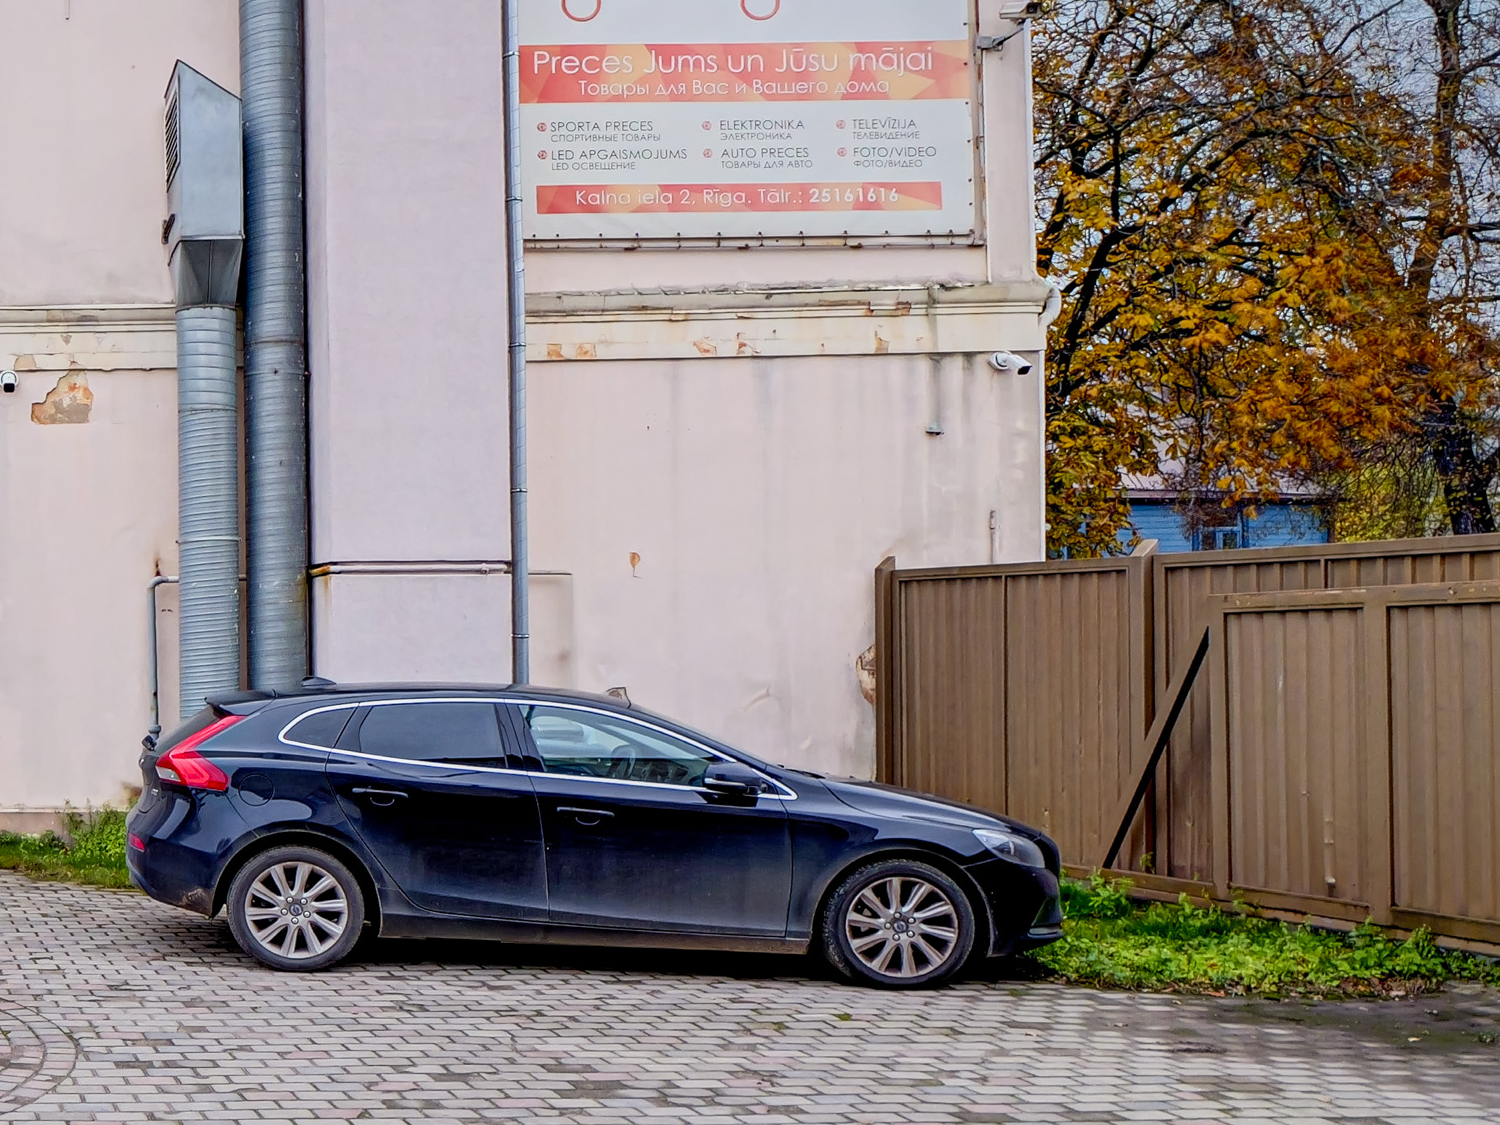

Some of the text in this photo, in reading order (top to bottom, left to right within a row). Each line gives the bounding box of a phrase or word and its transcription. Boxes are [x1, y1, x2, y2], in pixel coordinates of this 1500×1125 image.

[533, 46, 933, 77] Preces Jums un Jūsu mājai
[578, 79, 890, 99] Товары для Вас и Вашего дома
[550, 120, 654, 133] SPORTA PRECES
[720, 119, 805, 131] ELEKTRONIKA
[852, 117, 917, 130] TELEVĪZIJA
[550, 133, 661, 143] СПОРТИВНЫЕ ТОВАРЫ
[720, 132, 793, 141] ЭЛЕКТРОНИКА
[852, 131, 921, 140] ТЕЛЕВИДЕНИЕ
[551, 148, 688, 161] LED APGAISMOJUMS
[720, 147, 810, 159] AUTO PRECES
[853, 145, 937, 158] FOTO/VIDEO
[551, 161, 636, 171] LED ОСВЕЩЕНИЕ
[721, 159, 813, 169] ТОВАРЫ ДЛЯ АВТО
[853, 159, 923, 168] ФОТО/ВИДЕО
[575, 187, 900, 208] Kalna iela 2, Rīga. Tālr.: 25161616
